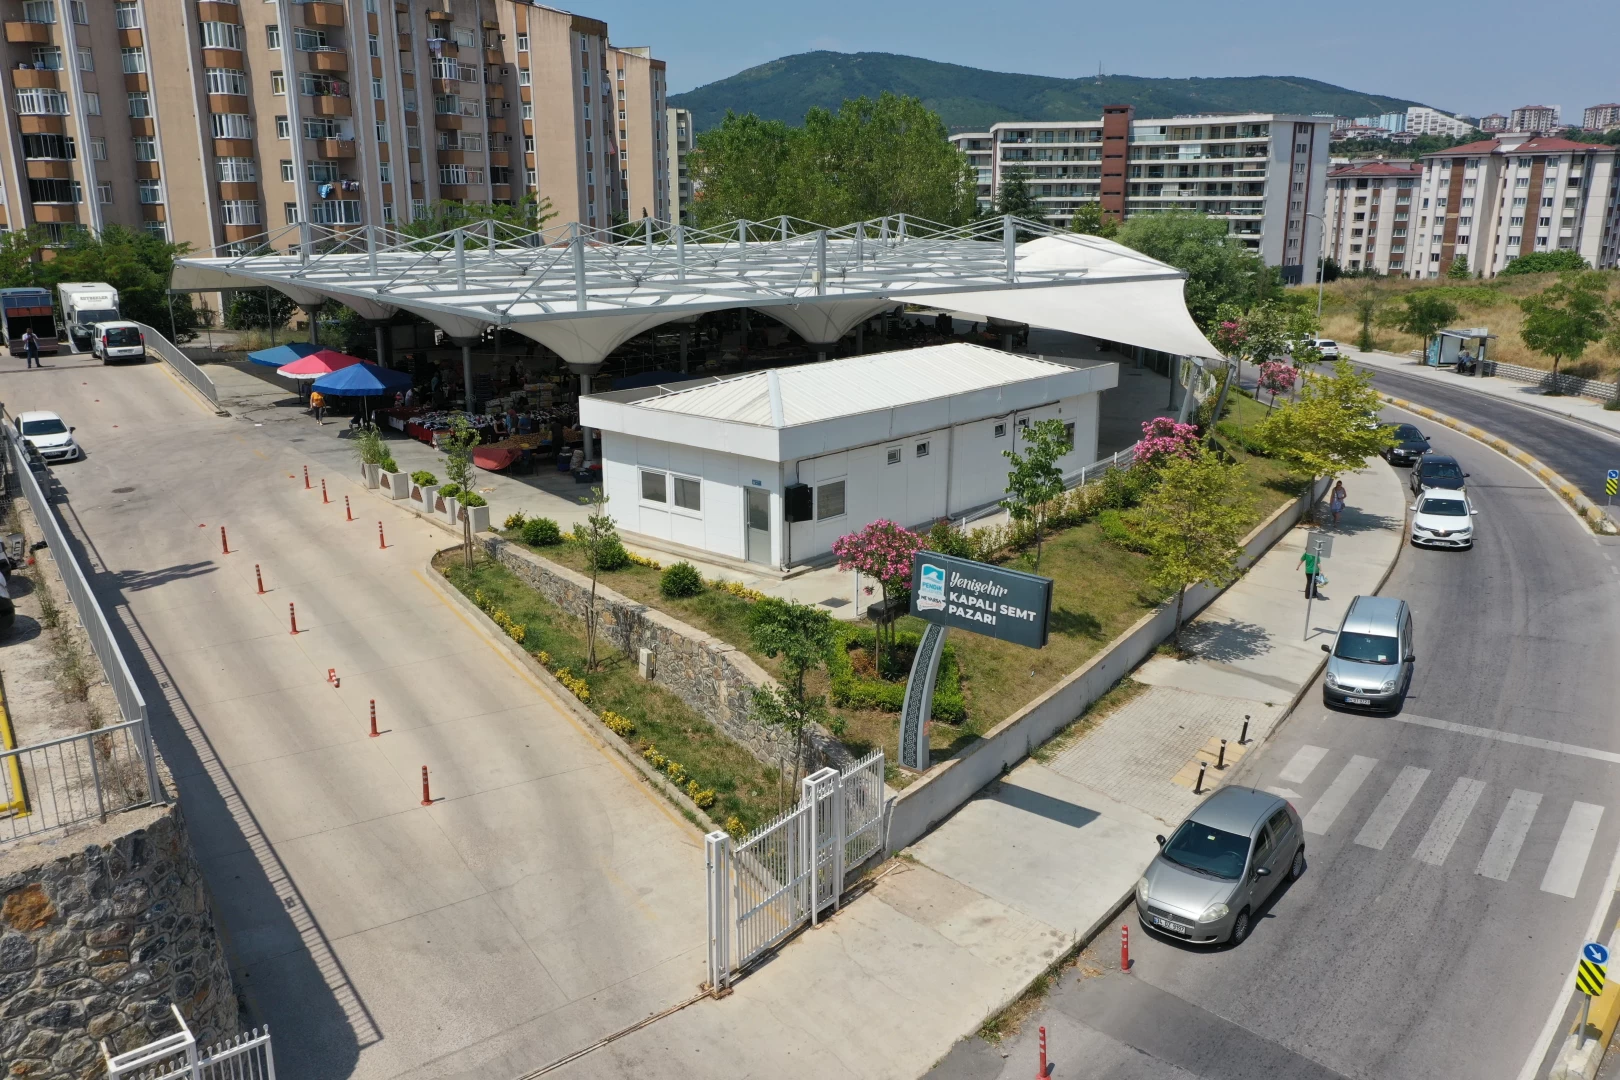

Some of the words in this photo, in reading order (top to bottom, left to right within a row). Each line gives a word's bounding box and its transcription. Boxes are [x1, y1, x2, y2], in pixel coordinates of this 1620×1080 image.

[950, 571, 1007, 597] Yenişehir
[948, 604, 996, 626] PAZARI
[949, 592, 996, 612] KAPALI
[1000, 604, 1036, 622] SEMT
